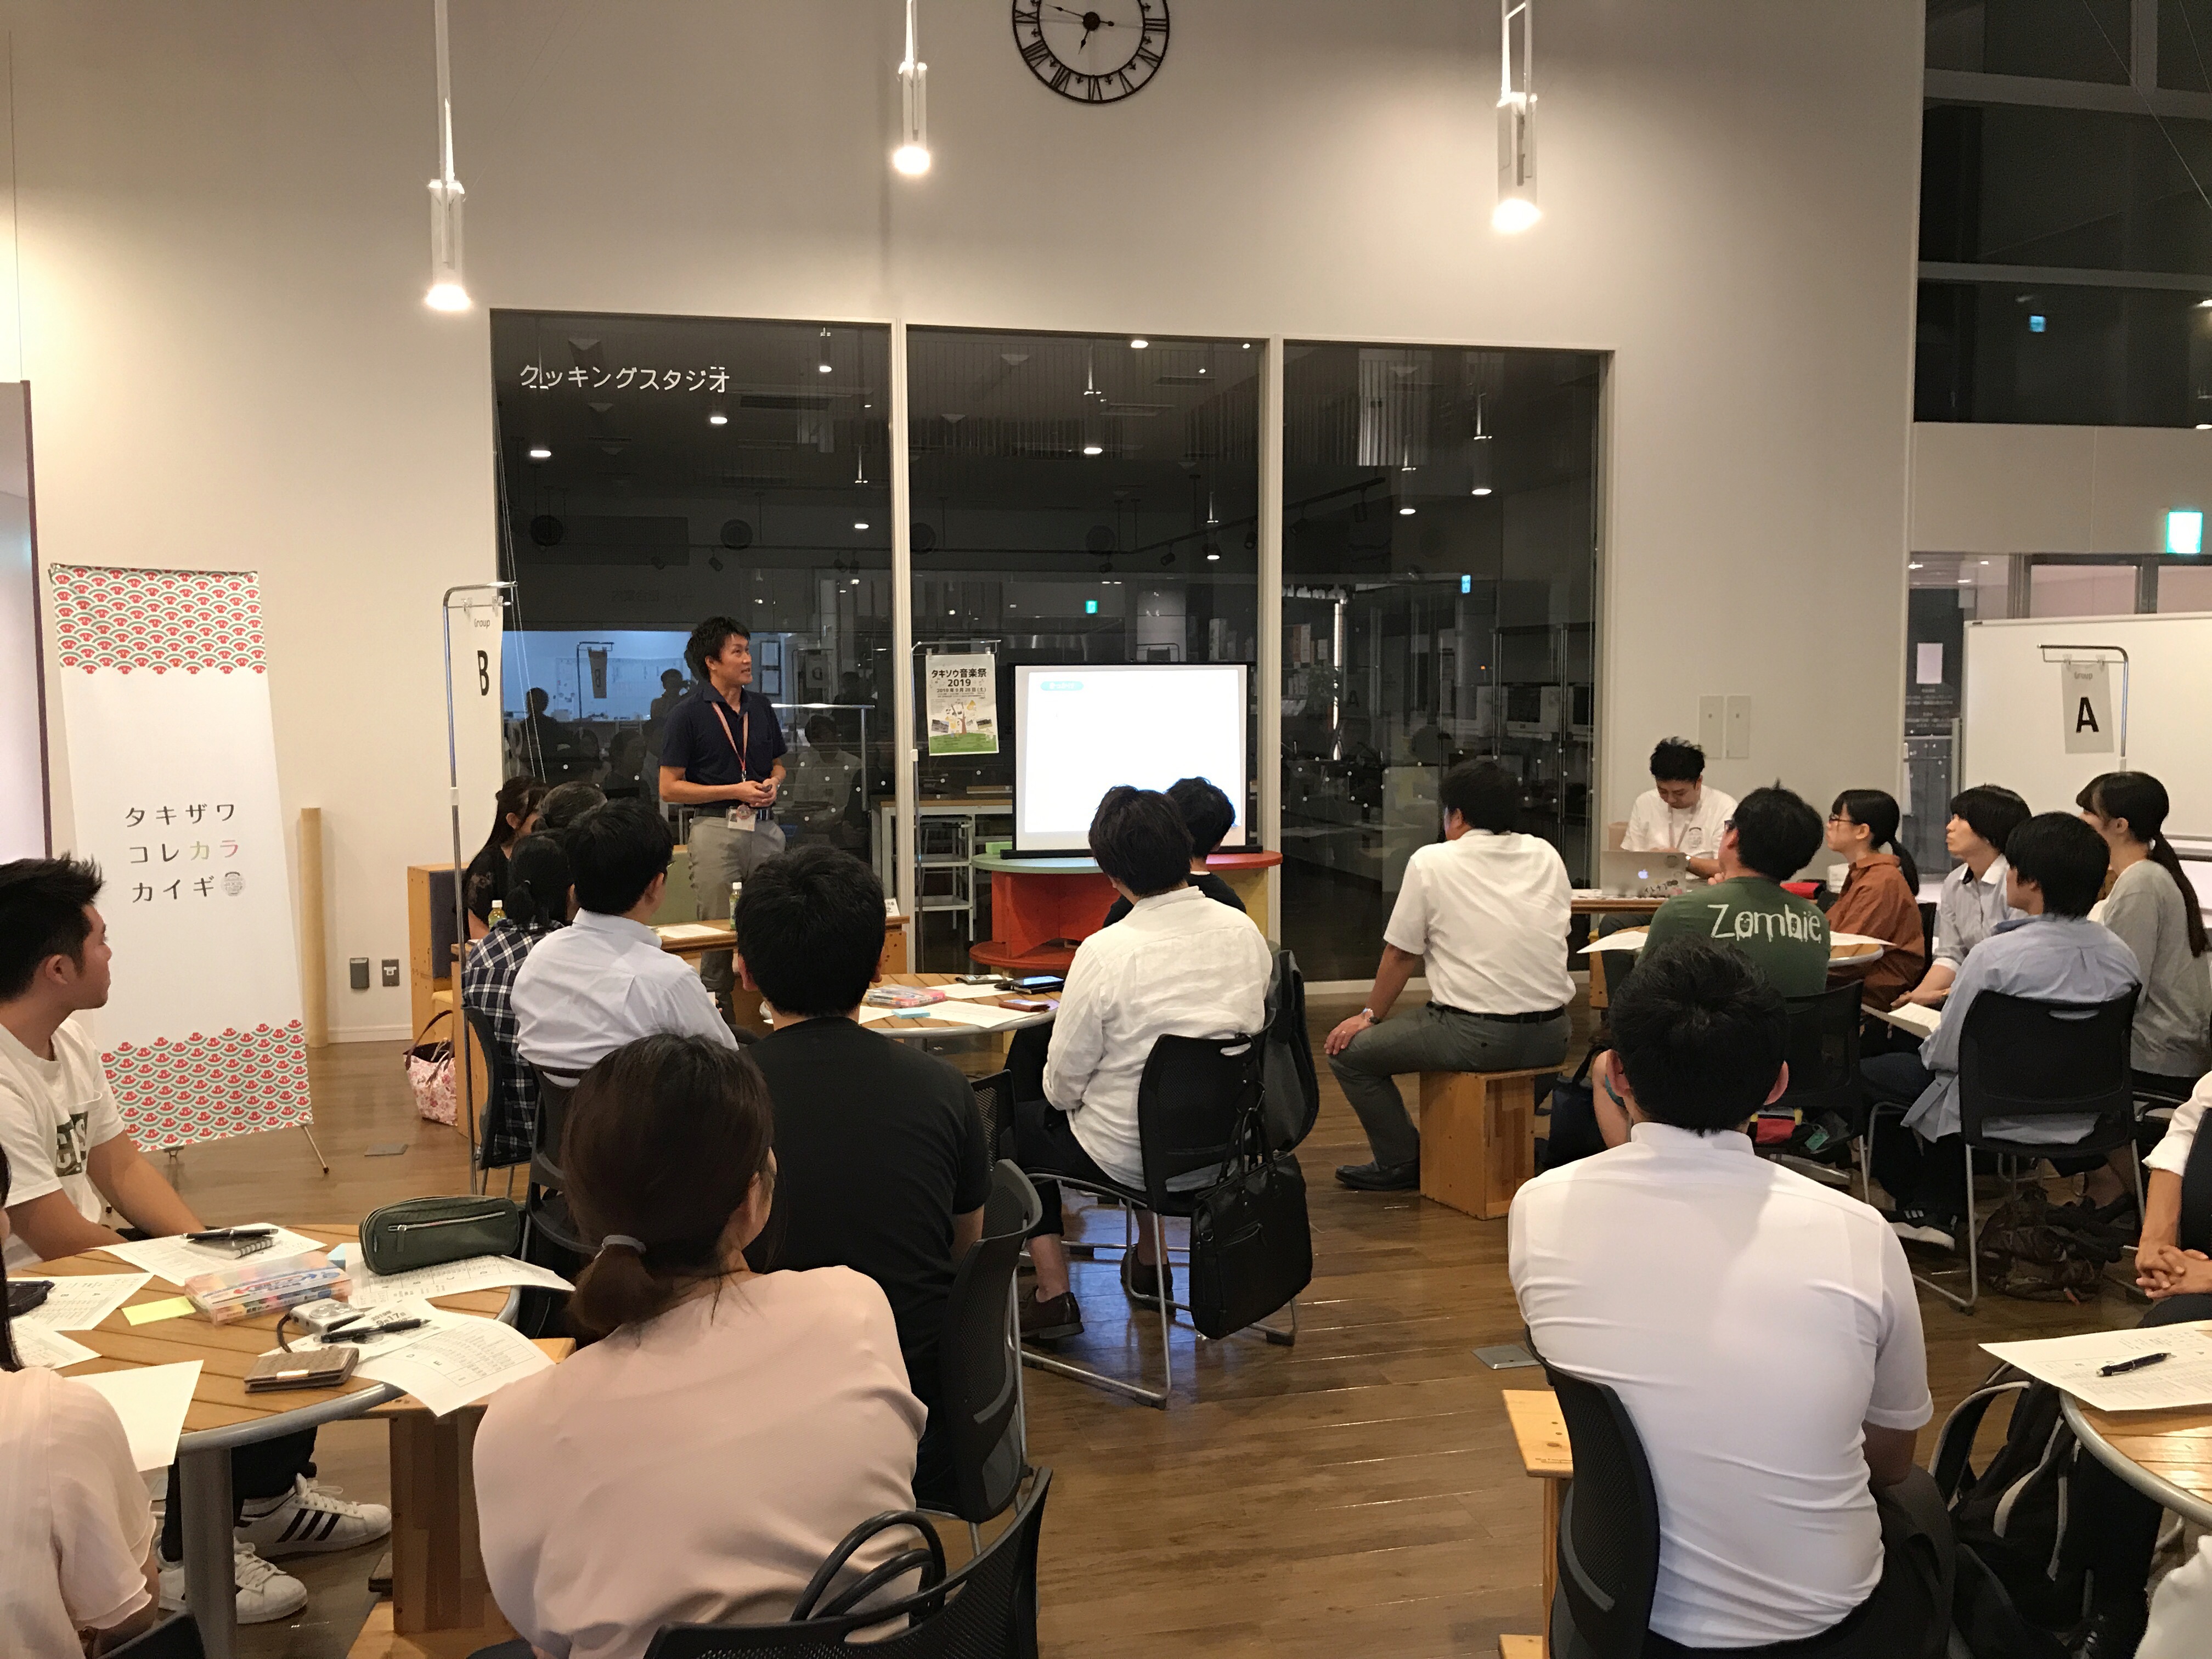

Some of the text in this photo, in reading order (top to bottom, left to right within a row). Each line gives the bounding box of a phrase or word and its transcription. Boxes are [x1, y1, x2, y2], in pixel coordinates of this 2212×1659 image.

[520, 364, 730, 392] クッキングスタジオ
[474, 618, 490, 629] Group
[477, 650, 489, 696] B
[2074, 672, 2093, 680] Group
[2075, 696, 2100, 733] A
[125, 803, 234, 827] タキザワ
[129, 840, 238, 864] コレカラ
[132, 875, 215, 903] カイギ
[1707, 904, 1822, 944] Zombie
